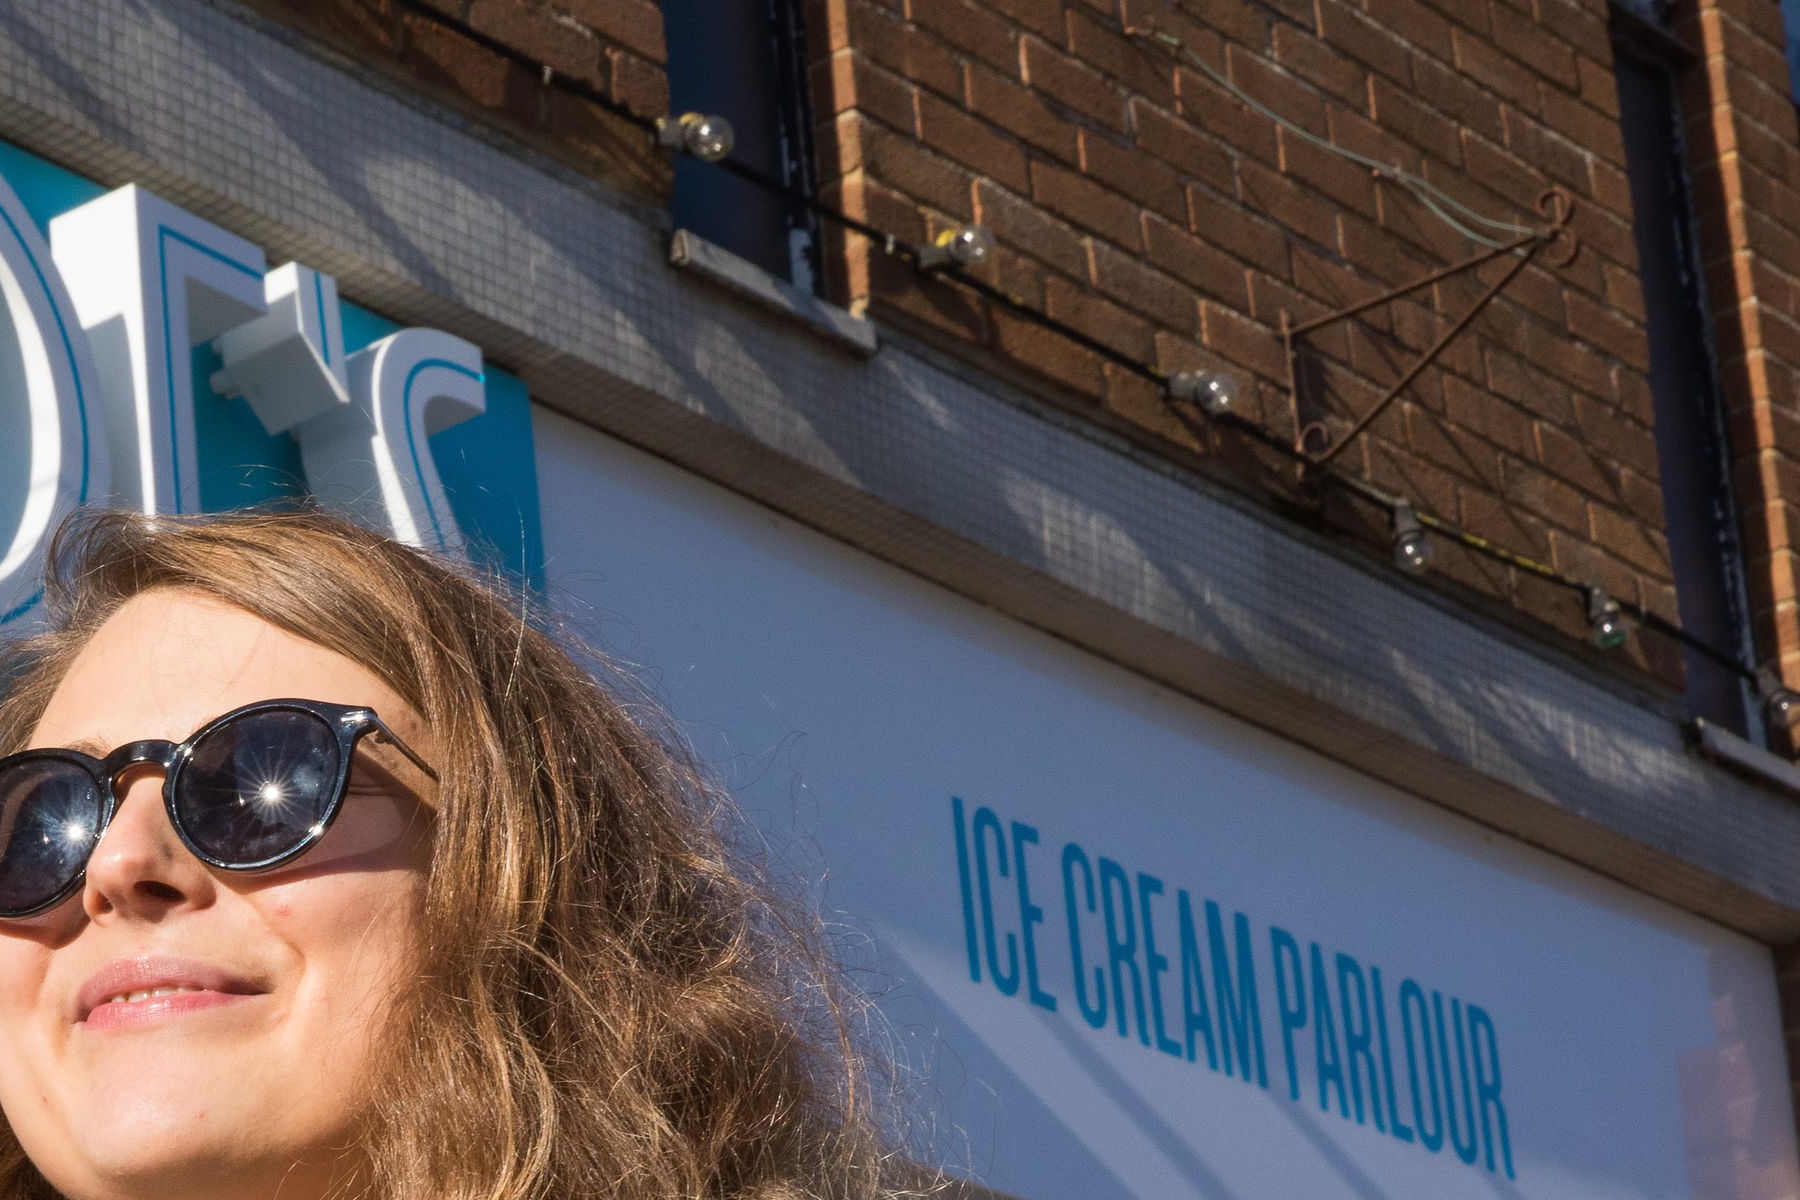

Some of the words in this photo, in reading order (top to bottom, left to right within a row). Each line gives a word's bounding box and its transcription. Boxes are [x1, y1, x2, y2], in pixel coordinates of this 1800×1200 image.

[952, 796, 1057, 1011] ICE
[1062, 843, 1269, 1090] CREAM
[1270, 925, 1516, 1180] PARLOUR
